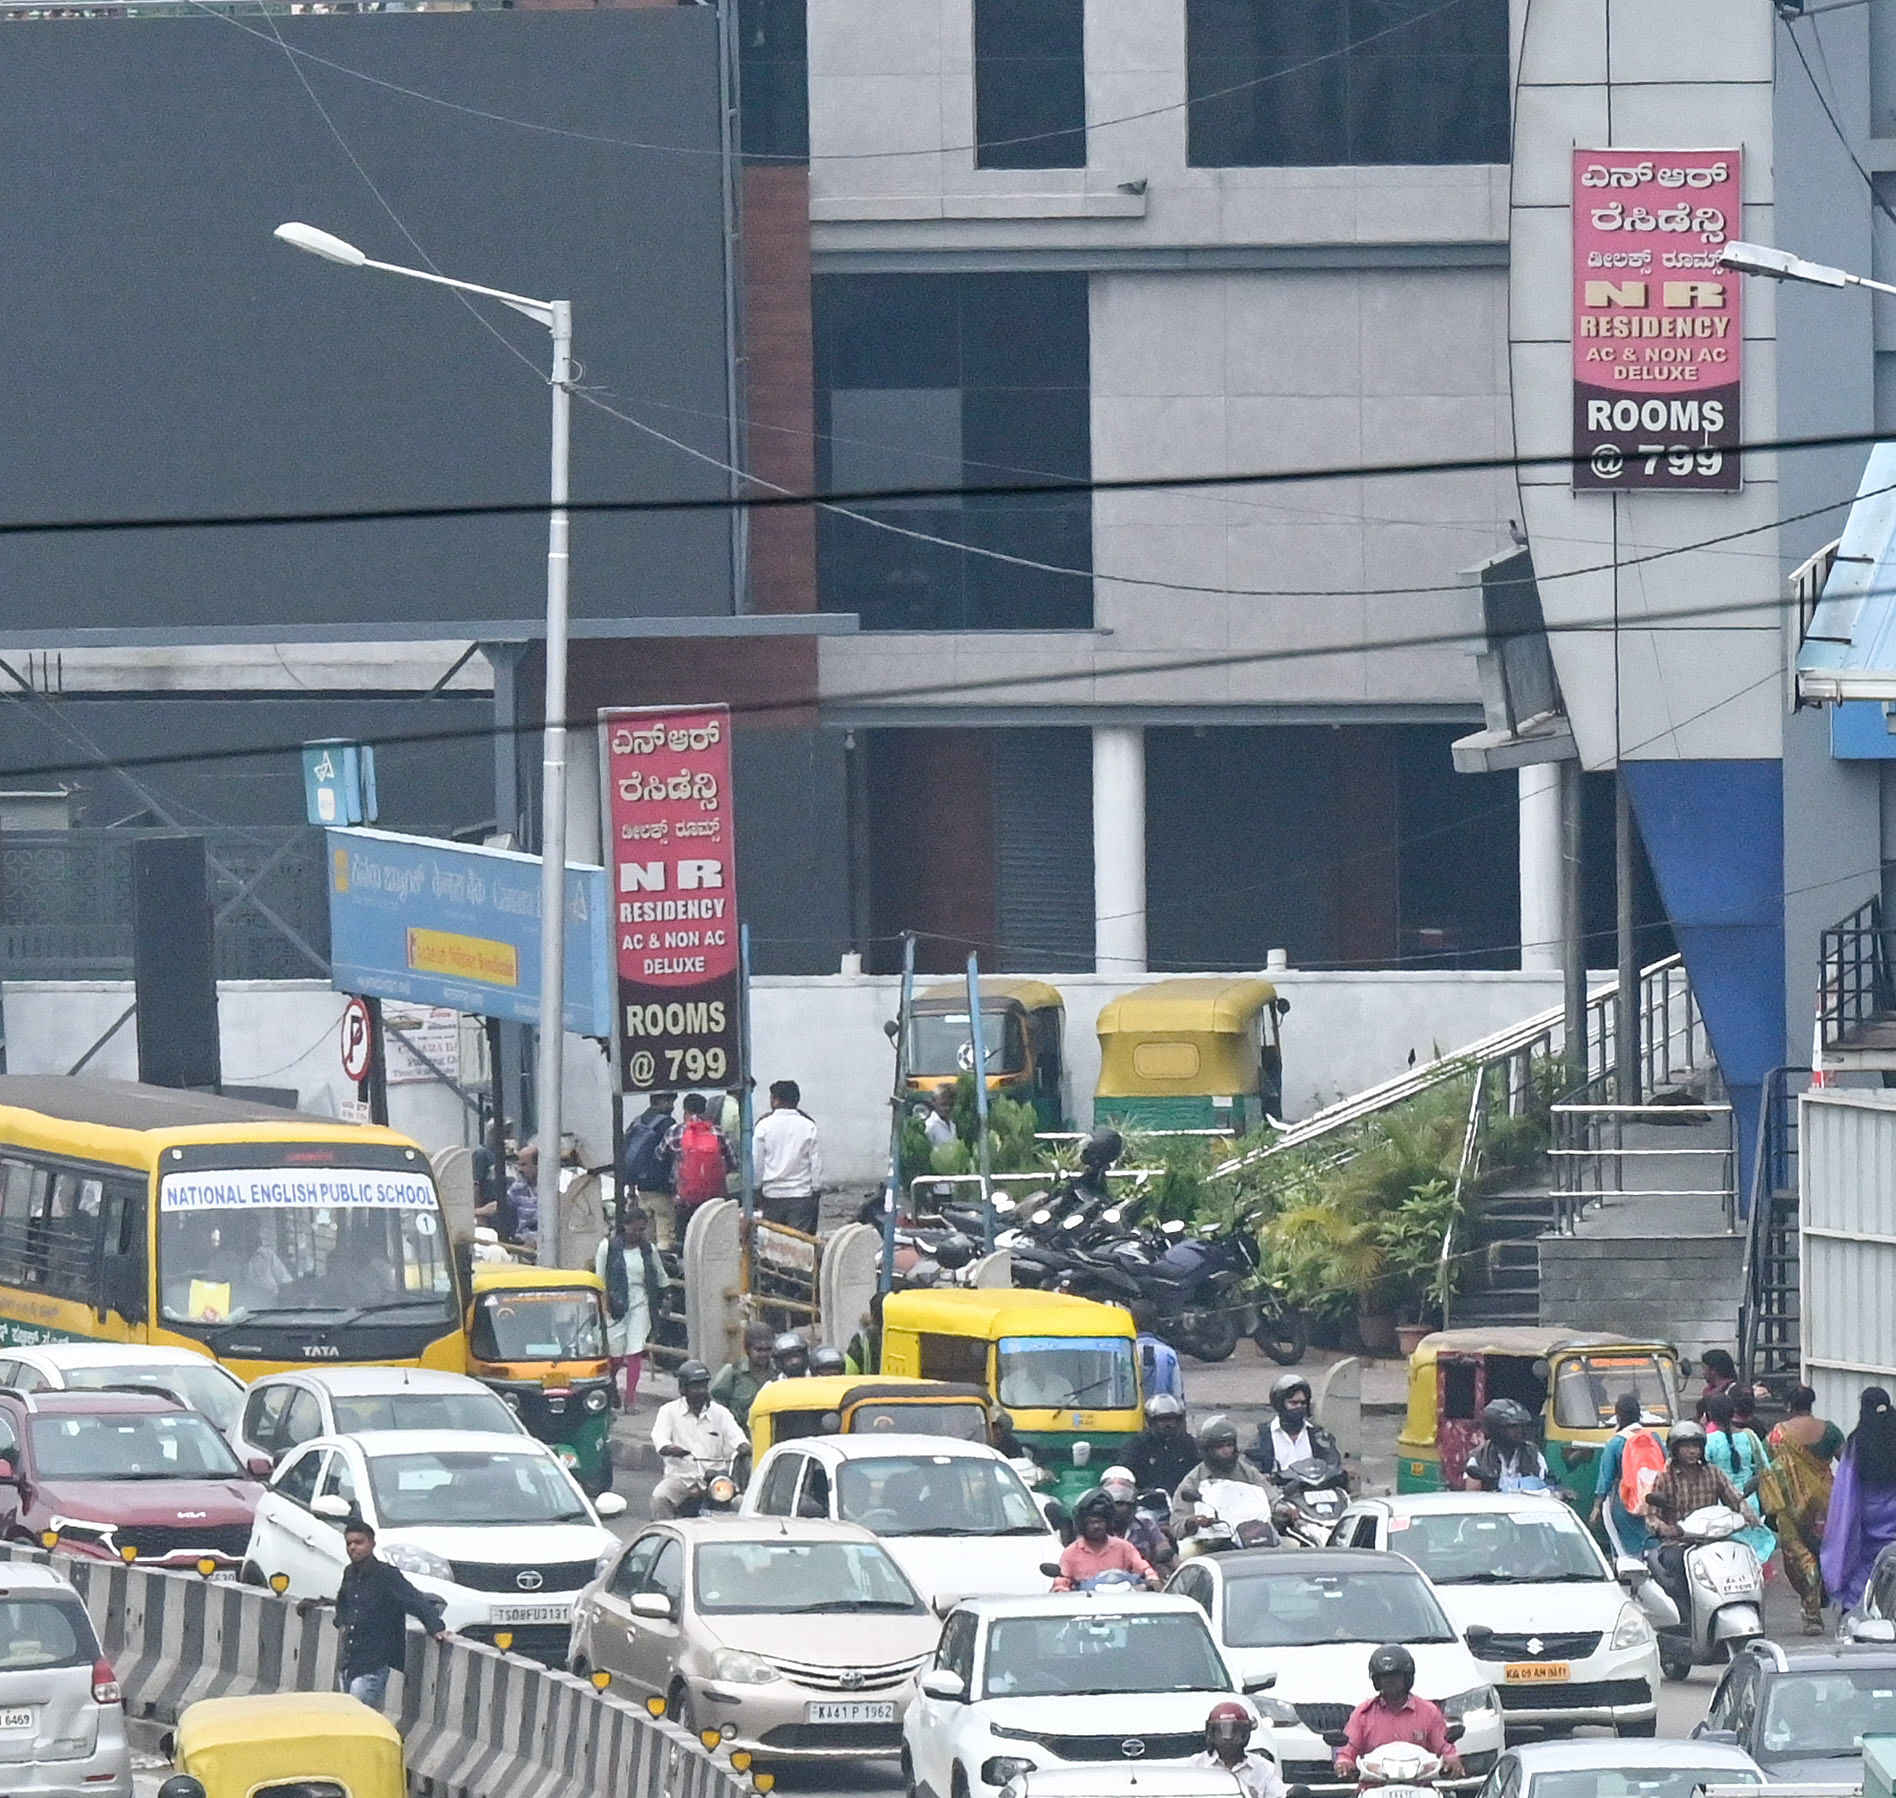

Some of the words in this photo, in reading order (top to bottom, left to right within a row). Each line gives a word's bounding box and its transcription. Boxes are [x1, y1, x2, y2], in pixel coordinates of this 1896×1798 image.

[1585, 281, 1646, 308] N
[1663, 281, 1727, 308] R
[1580, 316, 1730, 340] RESIDENCY
[1586, 348, 1616, 363] AC
[1622, 348, 1637, 363] &
[1644, 348, 1692, 363] NON
[1698, 348, 1728, 363] AC
[1613, 364, 1700, 382] DELUXE
[1587, 399, 1725, 432] ROOMS
[1590, 442, 1624, 479] @
[1638, 444, 1723, 477] 799
[619, 861, 665, 893] N
[677, 858, 723, 890] R
[620, 899, 725, 922] RESIDENCY
[622, 933, 644, 951] AC
[648, 932, 661, 949] &
[663, 931, 700, 949] NON
[704, 930, 726, 947] AC
[644, 956, 706, 976] DELUXE
[626, 1002, 726, 1037] ROOMS
[629, 1050, 655, 1088] @
[664, 1047, 726, 1081] 799
[167, 1184, 246, 1206] NATIONAL
[251, 1183, 318, 1204] ENGLISH
[320, 1182, 372, 1203] PUBLIC
[377, 1183, 434, 1206] SCHOOL
[302, 1345, 340, 1358] TATA
[865, 1703, 891, 1718] 1962
